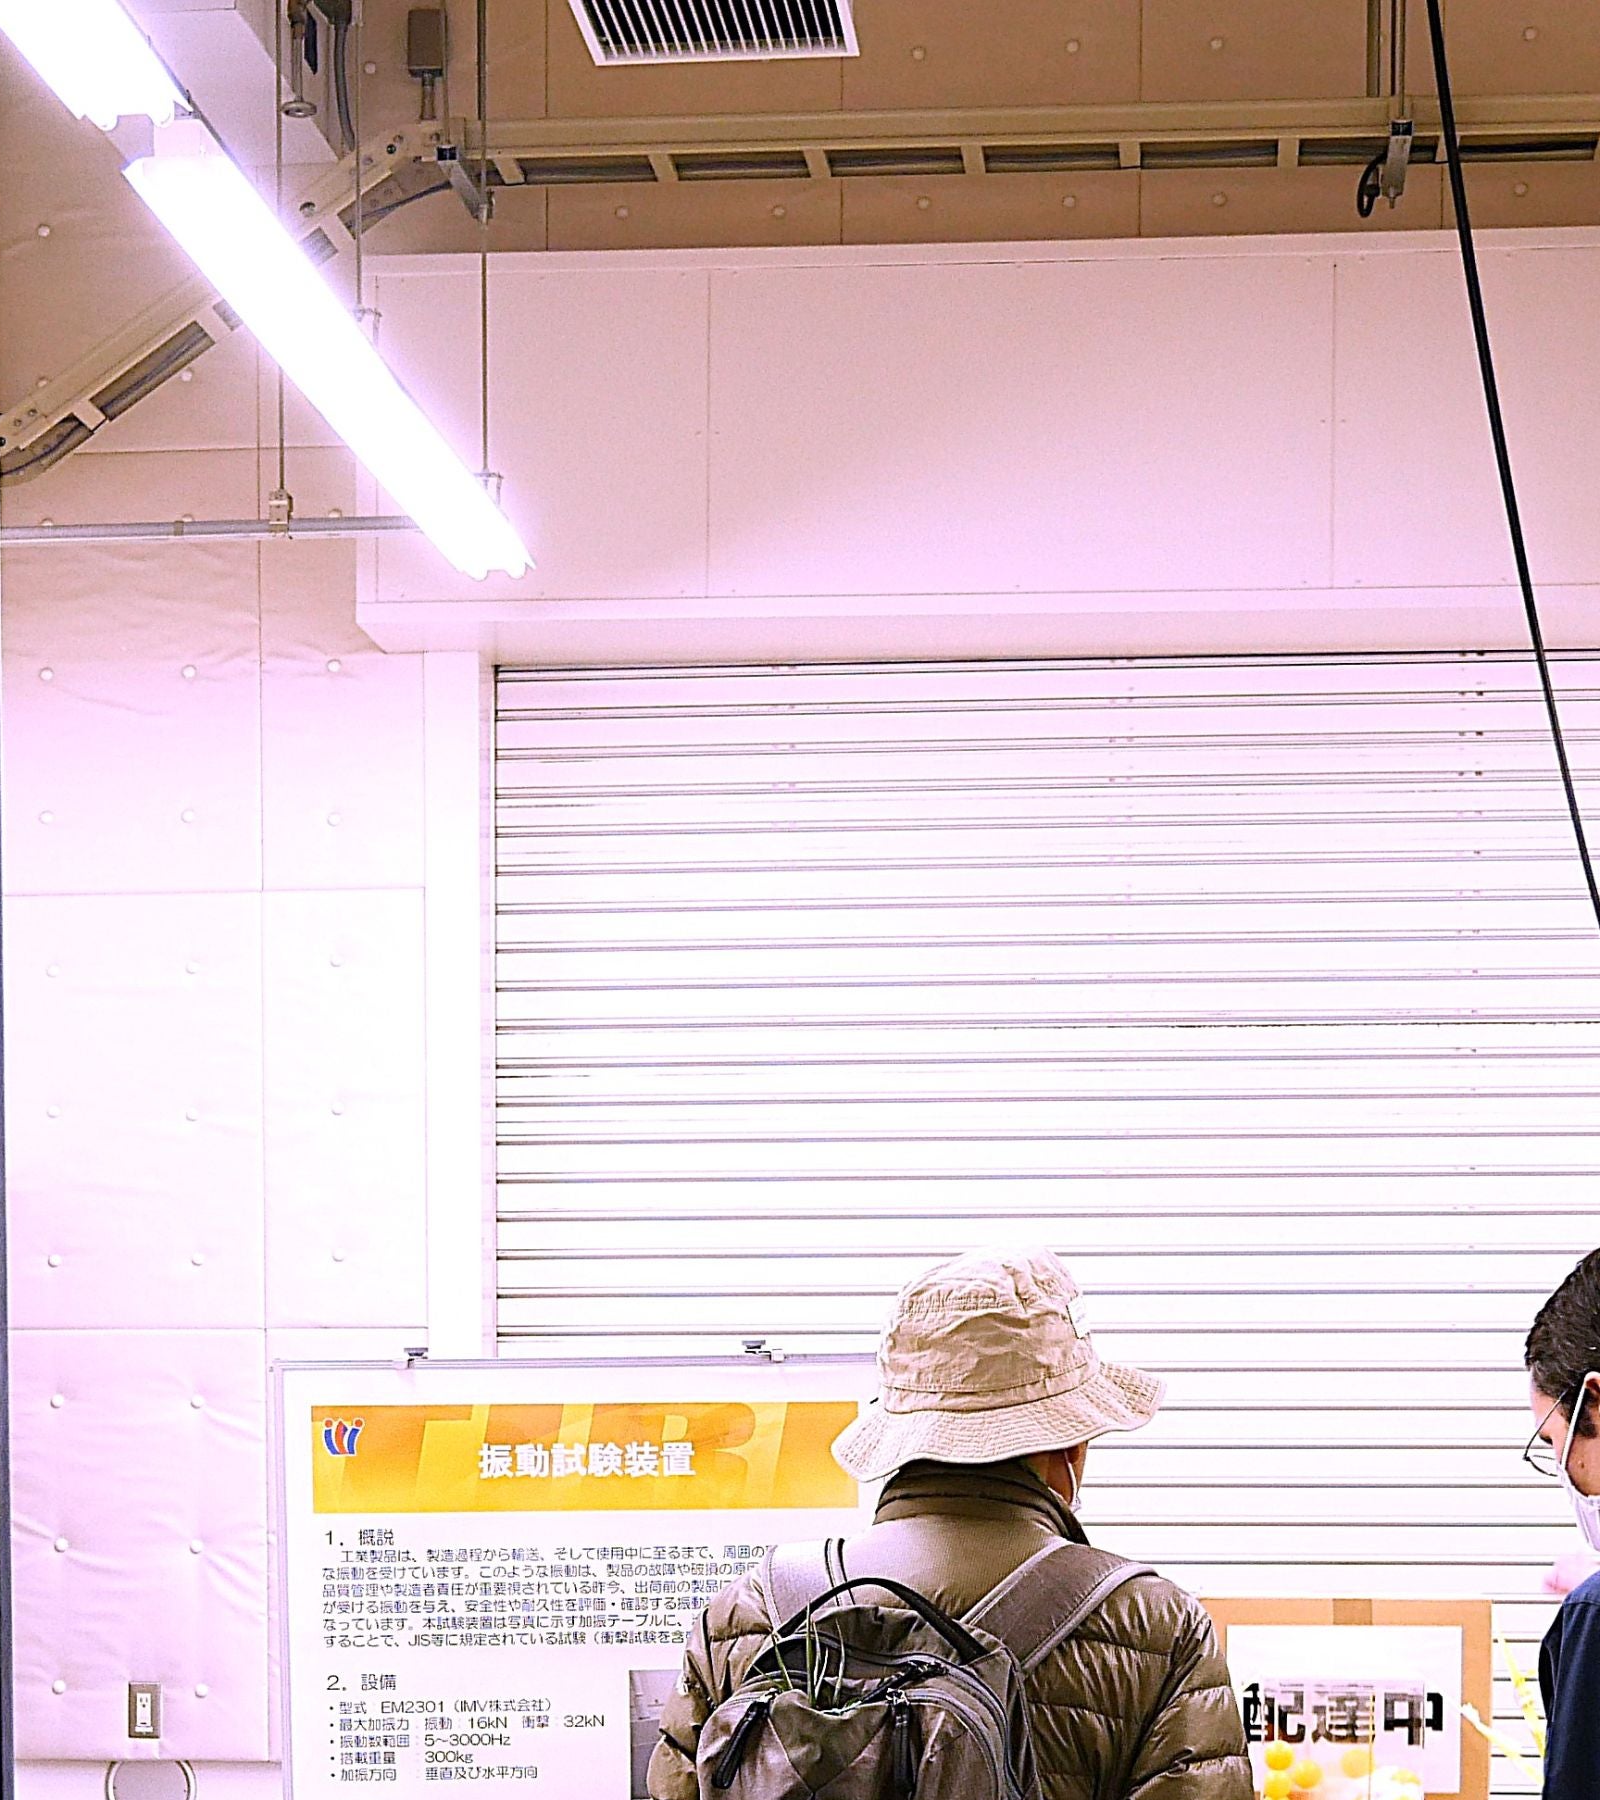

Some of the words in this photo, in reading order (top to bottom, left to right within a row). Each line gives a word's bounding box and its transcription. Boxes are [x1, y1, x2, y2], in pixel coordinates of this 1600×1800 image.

[478, 1442, 697, 1479] 振動試験装置
[341, 1545, 776, 1563] 工業製品は、製造過程から輸送、そして使用中に至るまで、周囲の
[323, 1597, 711, 1614] が受ける振動を与え、安全性や耐久性を評価・確認する振動
[324, 1630, 691, 1648] することで、JIS等に規定されている試験（衝撃試験を含
[1242, 1683, 1444, 1746] 配達中
